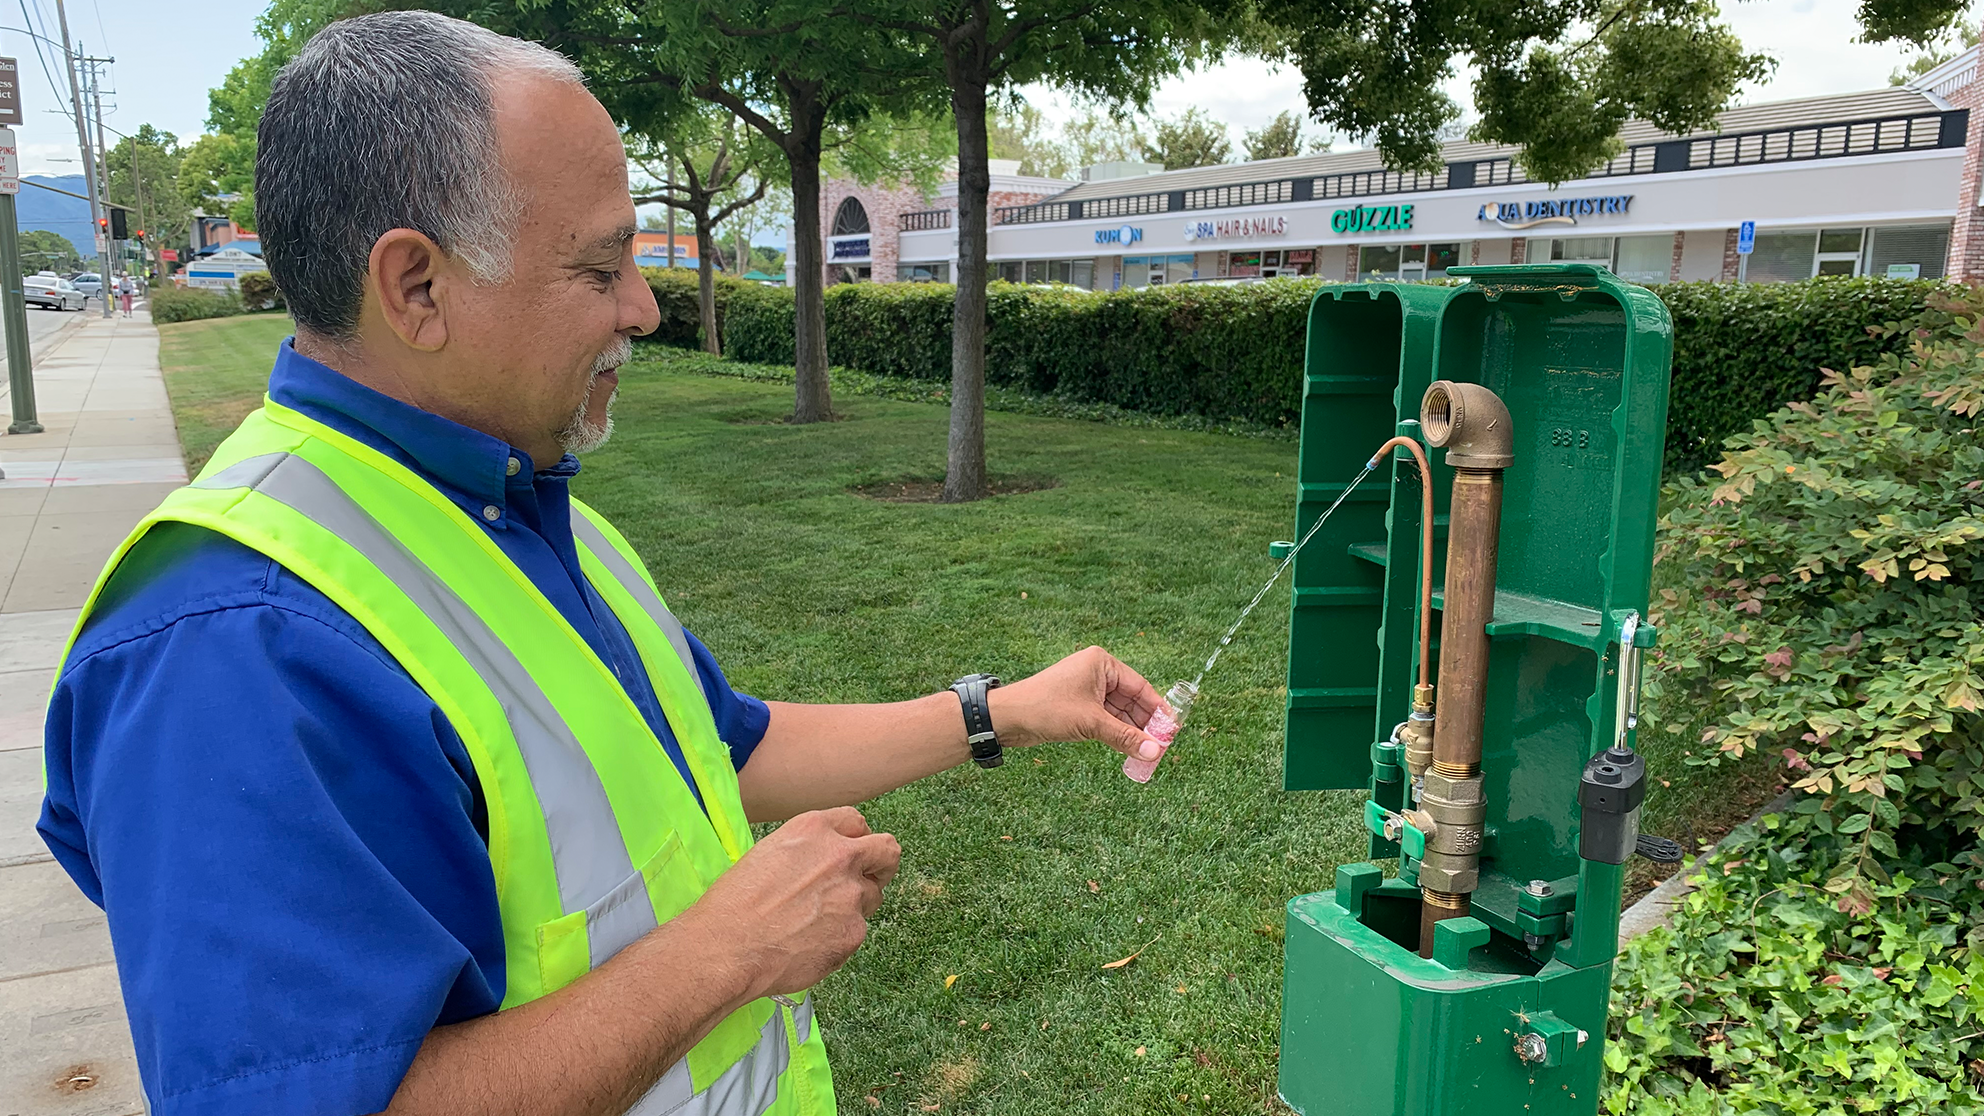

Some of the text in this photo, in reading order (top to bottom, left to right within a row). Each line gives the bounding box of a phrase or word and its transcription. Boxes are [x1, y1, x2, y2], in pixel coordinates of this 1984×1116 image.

[1525, 195, 1635, 219] DENTISTRY
[1095, 225, 1143, 246] KUMON
[1196, 222, 1215, 239] SPA
[1216, 219, 1240, 237] HAIR
[1242, 218, 1250, 236] &
[1252, 216, 1286, 235] NAILS
[1455, 827, 1466, 853] ZURN
